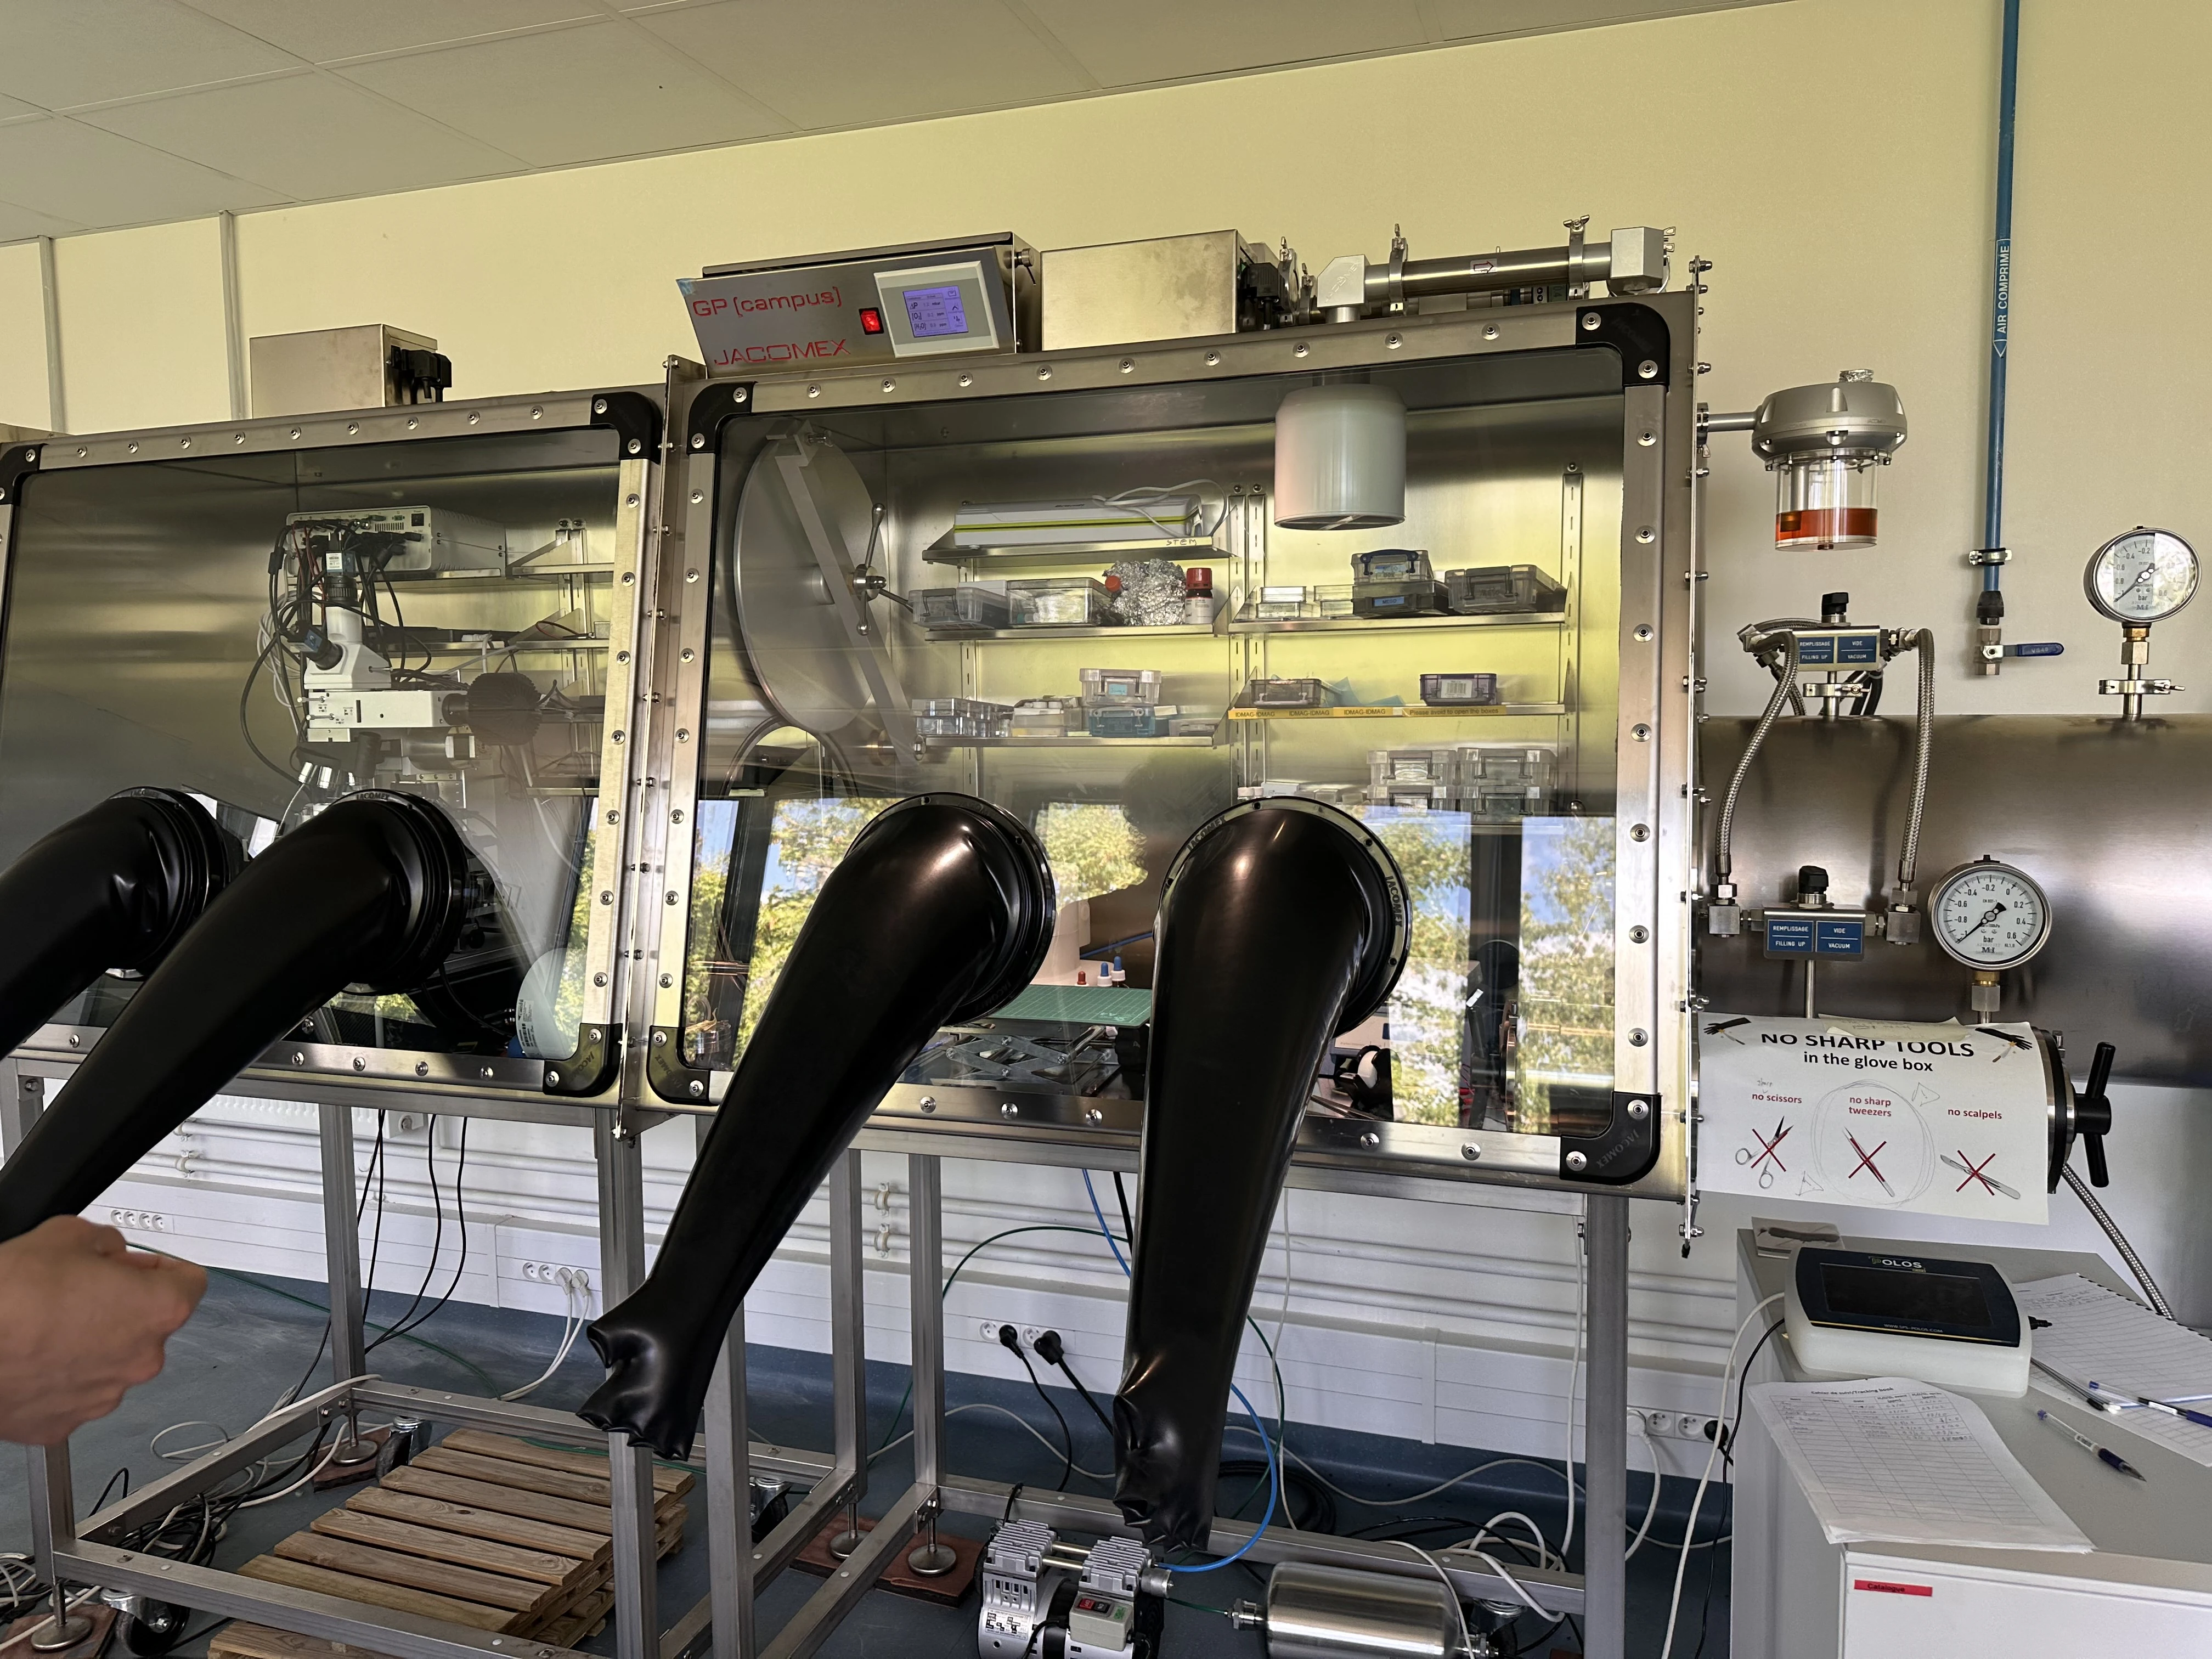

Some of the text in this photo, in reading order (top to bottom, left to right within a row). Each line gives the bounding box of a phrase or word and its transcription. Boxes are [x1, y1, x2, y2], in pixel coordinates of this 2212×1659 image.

[1997, 246, 2010, 334] AIR COMPRIME
[692, 298, 727, 317] GP
[714, 338, 851, 366] JACOMEX
[1761, 1033, 1798, 1045] NO
[1805, 1035, 1885, 1051] SHARP
[1804, 1052, 1933, 1071] in the glove box
[1767, 1093, 1802, 1104] scissors
[1865, 1096, 1892, 1107] sharp
[1849, 1106, 1892, 1117] tweezers
[1963, 1109, 2002, 1120] scalpels
